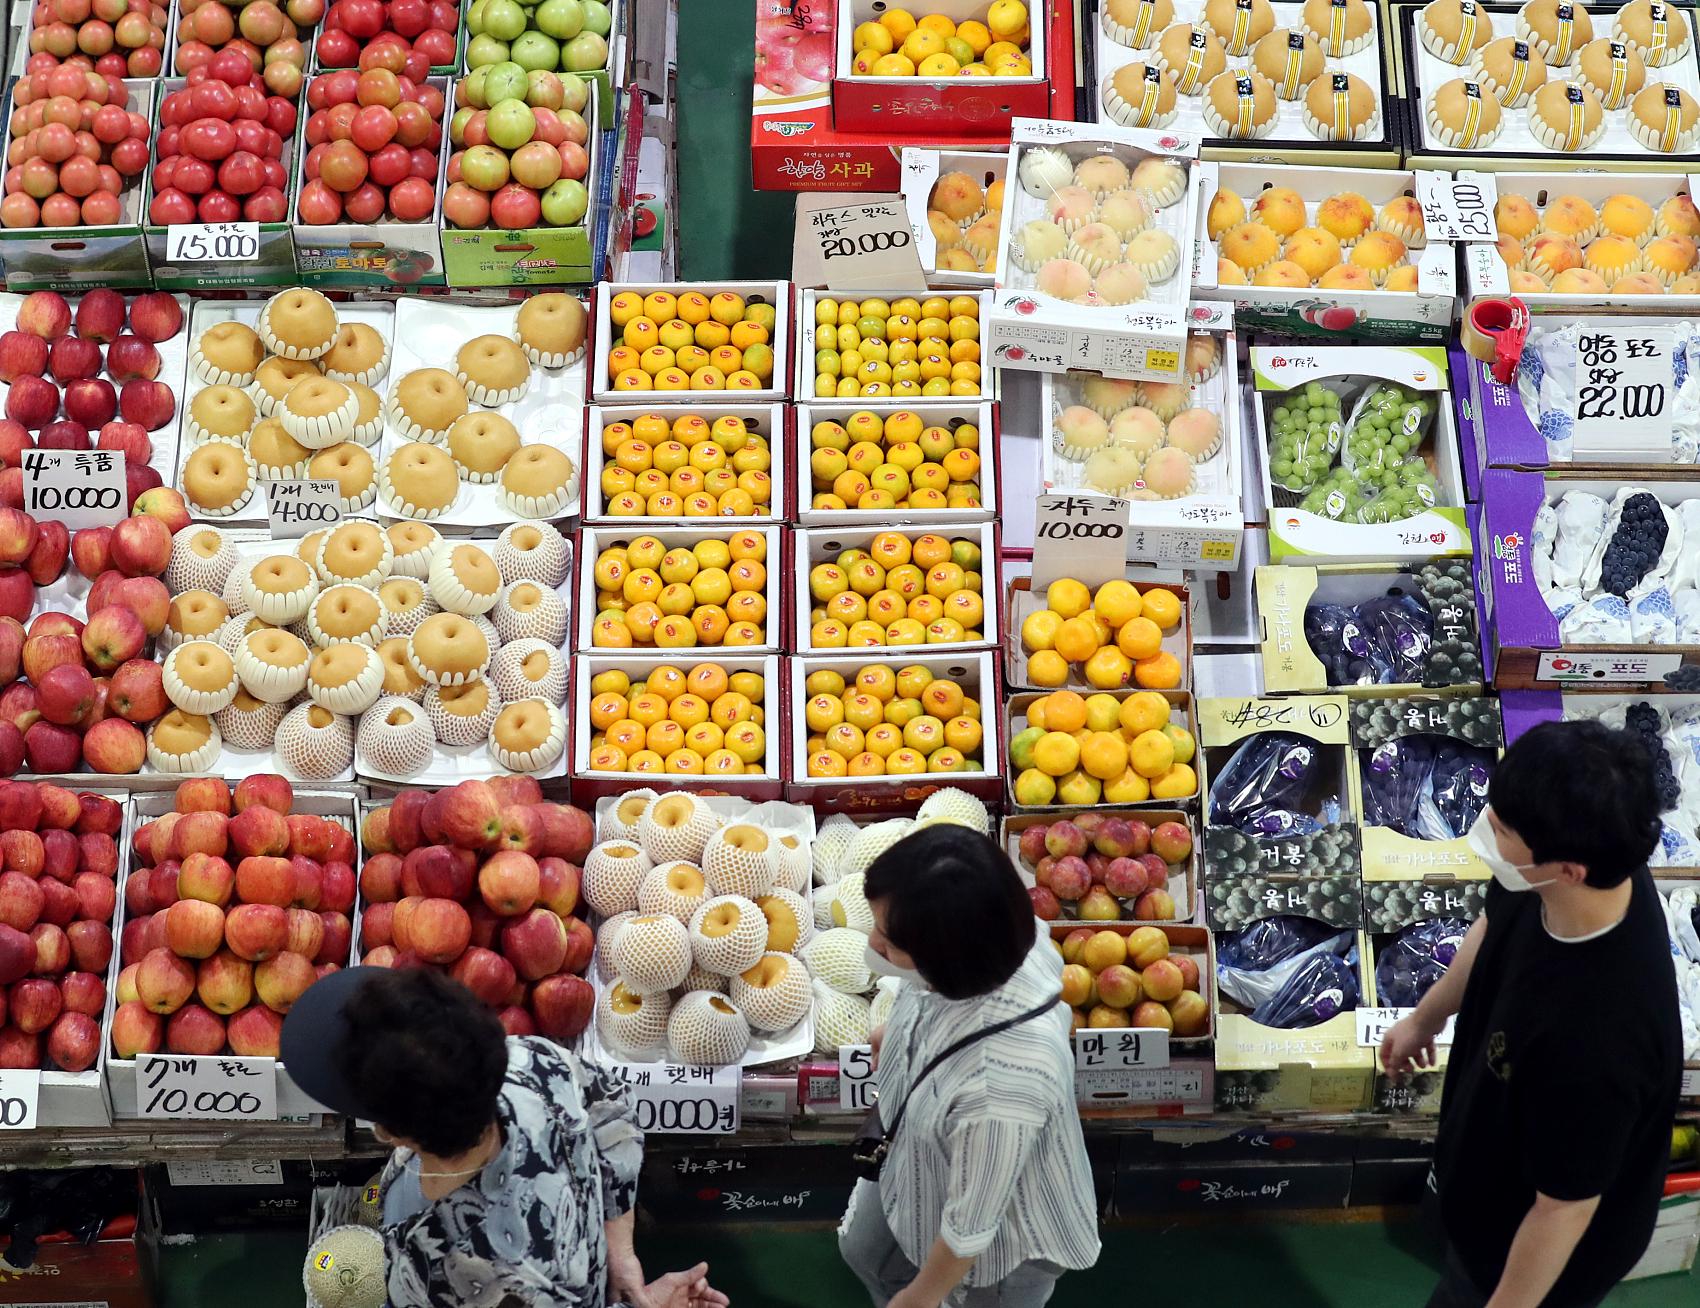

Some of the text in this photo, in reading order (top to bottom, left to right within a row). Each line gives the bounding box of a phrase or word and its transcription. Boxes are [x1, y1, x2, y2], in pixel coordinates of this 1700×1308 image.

[777, 157, 875, 180] 함양 사과
[1424, 202, 1448, 223] 황도
[1452, 184, 1492, 235] 25.000
[175, 234, 257, 260] 15.000
[820, 231, 910, 260] 20.000
[335, 257, 386, 270] 토마토
[1236, 300, 1291, 313] 주복숭아
[1124, 315, 1177, 331] 청도복숭아
[1578, 333, 1662, 367] 영동 포도
[1492, 386, 1506, 406] 포도
[1577, 383, 1665, 421] 22.000
[74, 453, 114, 476] 특품
[31, 487, 121, 510] 10.000
[1049, 496, 1095, 516] 자두
[272, 500, 340, 522] 4.000
[1179, 508, 1233, 523] 청도복숭아
[1037, 521, 1124, 541] 10.000
[1504, 561, 1518, 583] 포도
[1440, 604, 1464, 641] 거봉
[1610, 663, 1648, 675] 포도
[1403, 708, 1447, 728] 거봉
[1261, 846, 1305, 866] 거봉
[1262, 889, 1307, 911] 거봉
[1419, 892, 1463, 912] 거봉
[664, 1065, 714, 1086] 햇배
[0, 1097, 27, 1126] 0
[145, 1088, 262, 1115] 10.000
[636, 1098, 735, 1131] 0.000원
